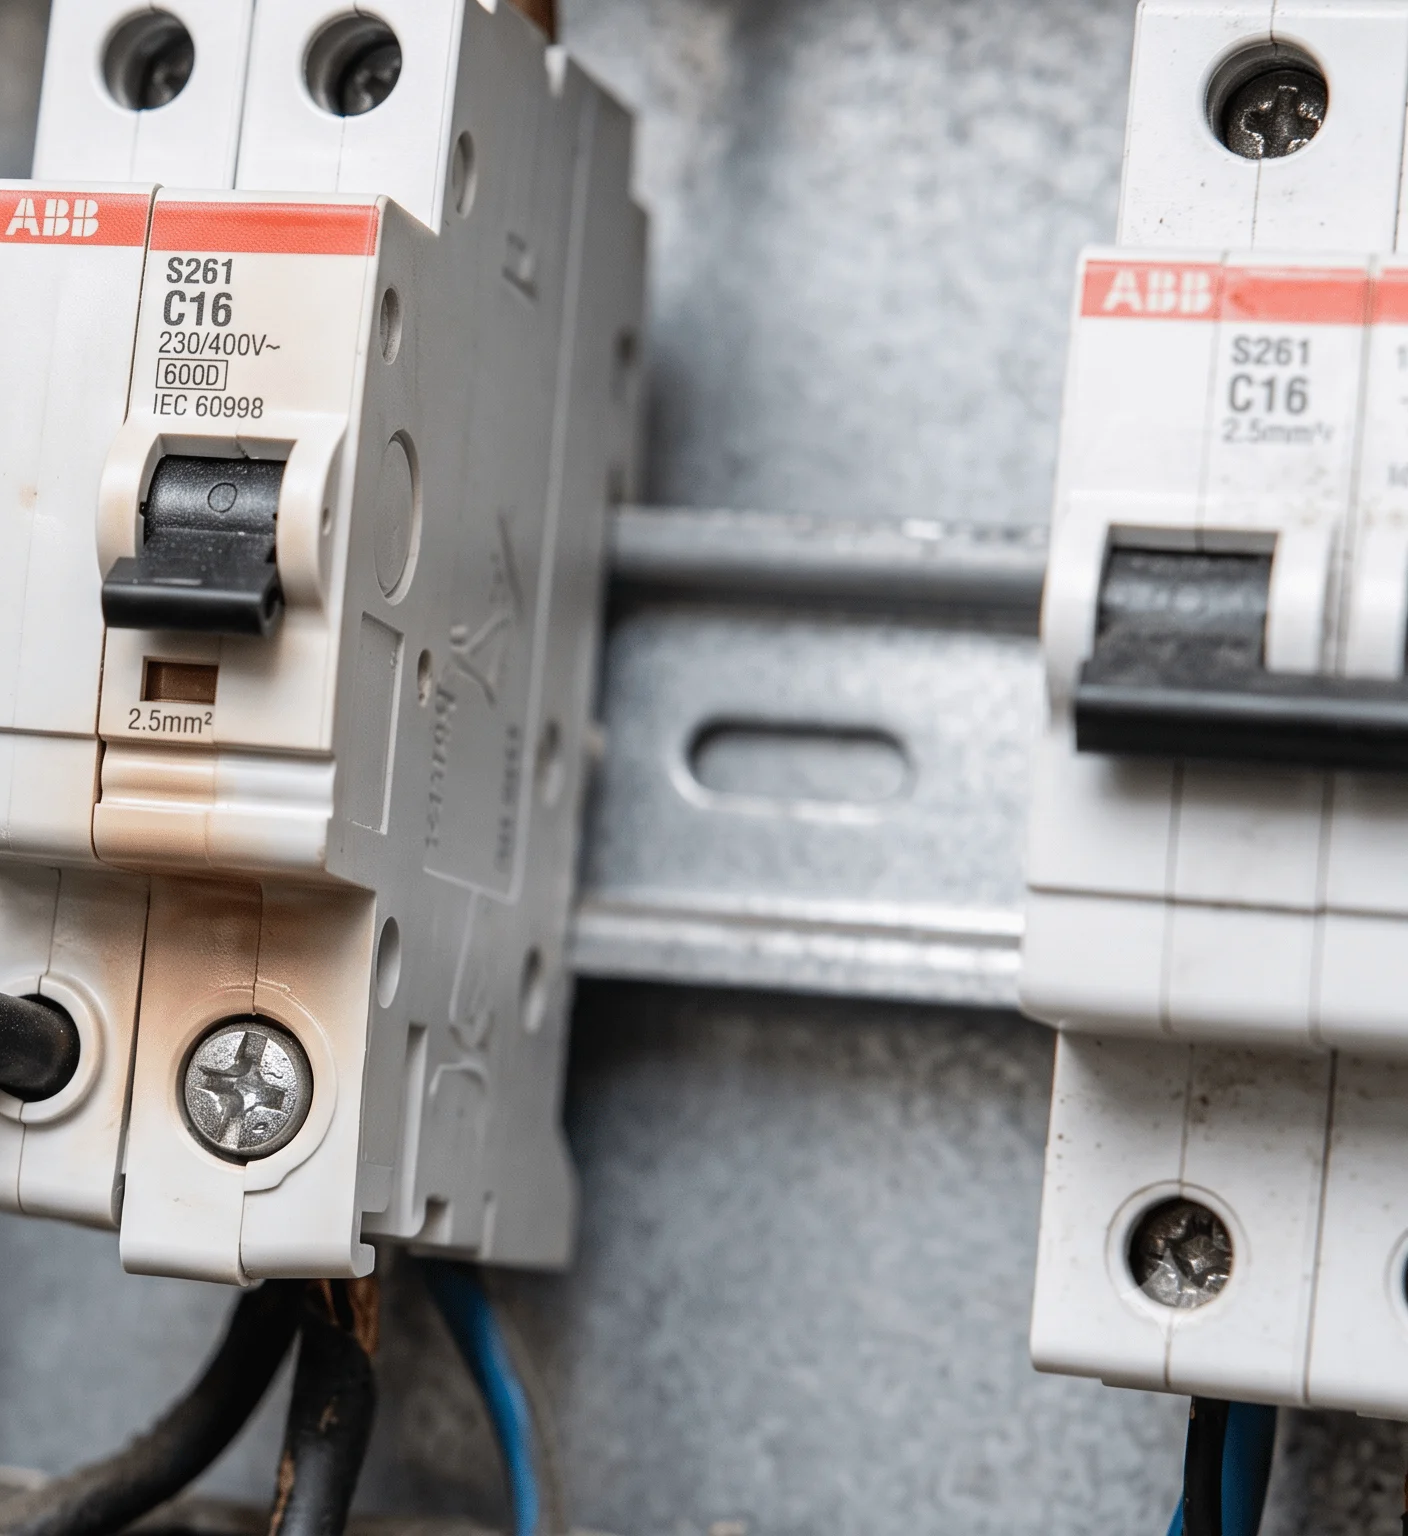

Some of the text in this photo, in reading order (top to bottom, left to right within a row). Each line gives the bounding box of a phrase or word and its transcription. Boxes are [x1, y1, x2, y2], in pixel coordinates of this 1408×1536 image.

[5, 197, 99, 238] ABB
[166, 257, 234, 285] S261
[1103, 269, 1212, 313] ABB
[163, 290, 233, 327] C16
[1231, 335, 1310, 368] S261
[164, 364, 220, 386] 600D
[153, 394, 264, 419] IEC 60998
[1228, 374, 1310, 415] C16
[128, 708, 213, 734] 2.5mm²
